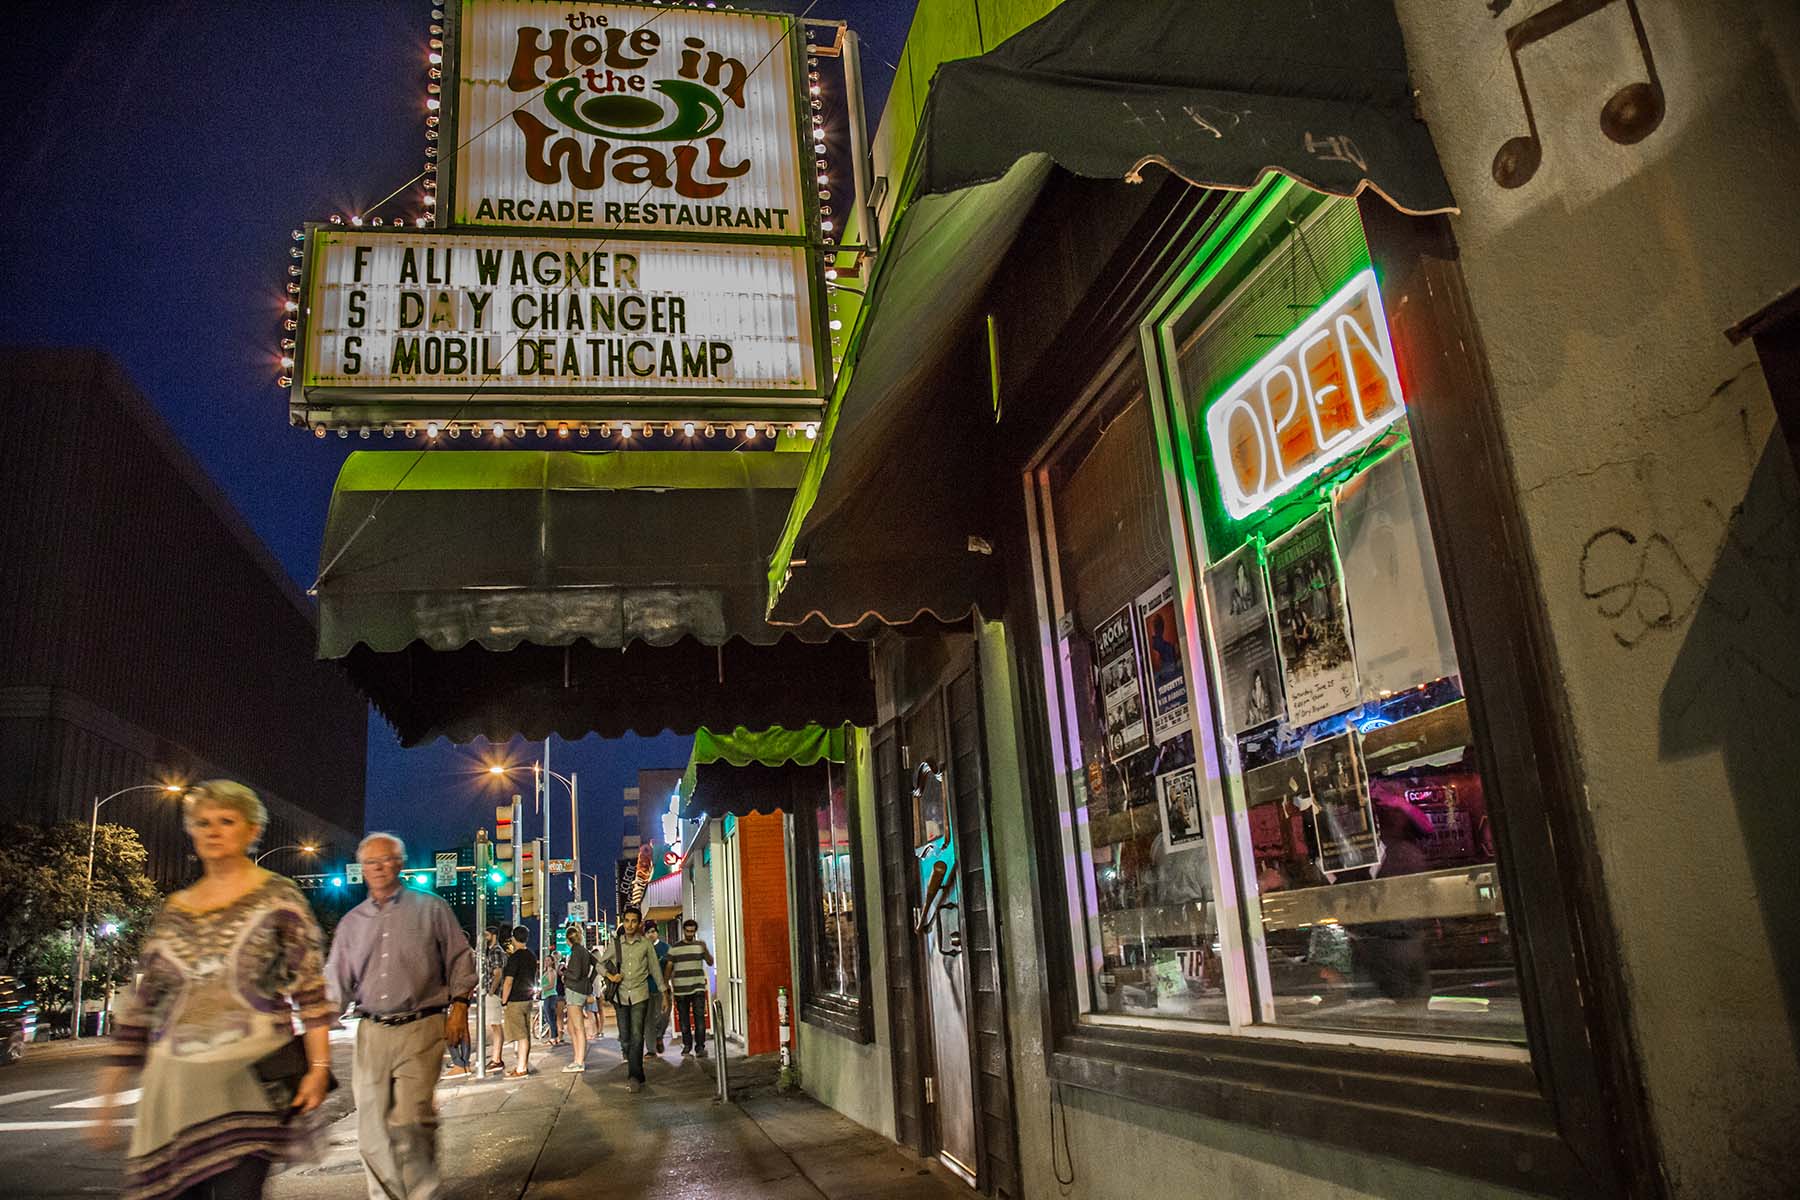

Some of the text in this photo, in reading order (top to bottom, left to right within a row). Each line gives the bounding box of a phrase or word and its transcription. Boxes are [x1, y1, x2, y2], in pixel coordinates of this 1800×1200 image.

[565, 11, 609, 31] the
[582, 68, 646, 94] the
[678, 37, 747, 108] in
[475, 198, 790, 230] ARCADE RESTAURANT
[353, 246, 640, 289] F ALI WAGNER
[347, 290, 686, 333] S DAY CHANGER
[343, 336, 362, 375] S
[391, 336, 502, 375] MOBIL
[1225, 313, 1400, 505] OPEN
[1102, 618, 1125, 649] ROCK
[1177, 951, 1203, 977] TIP
